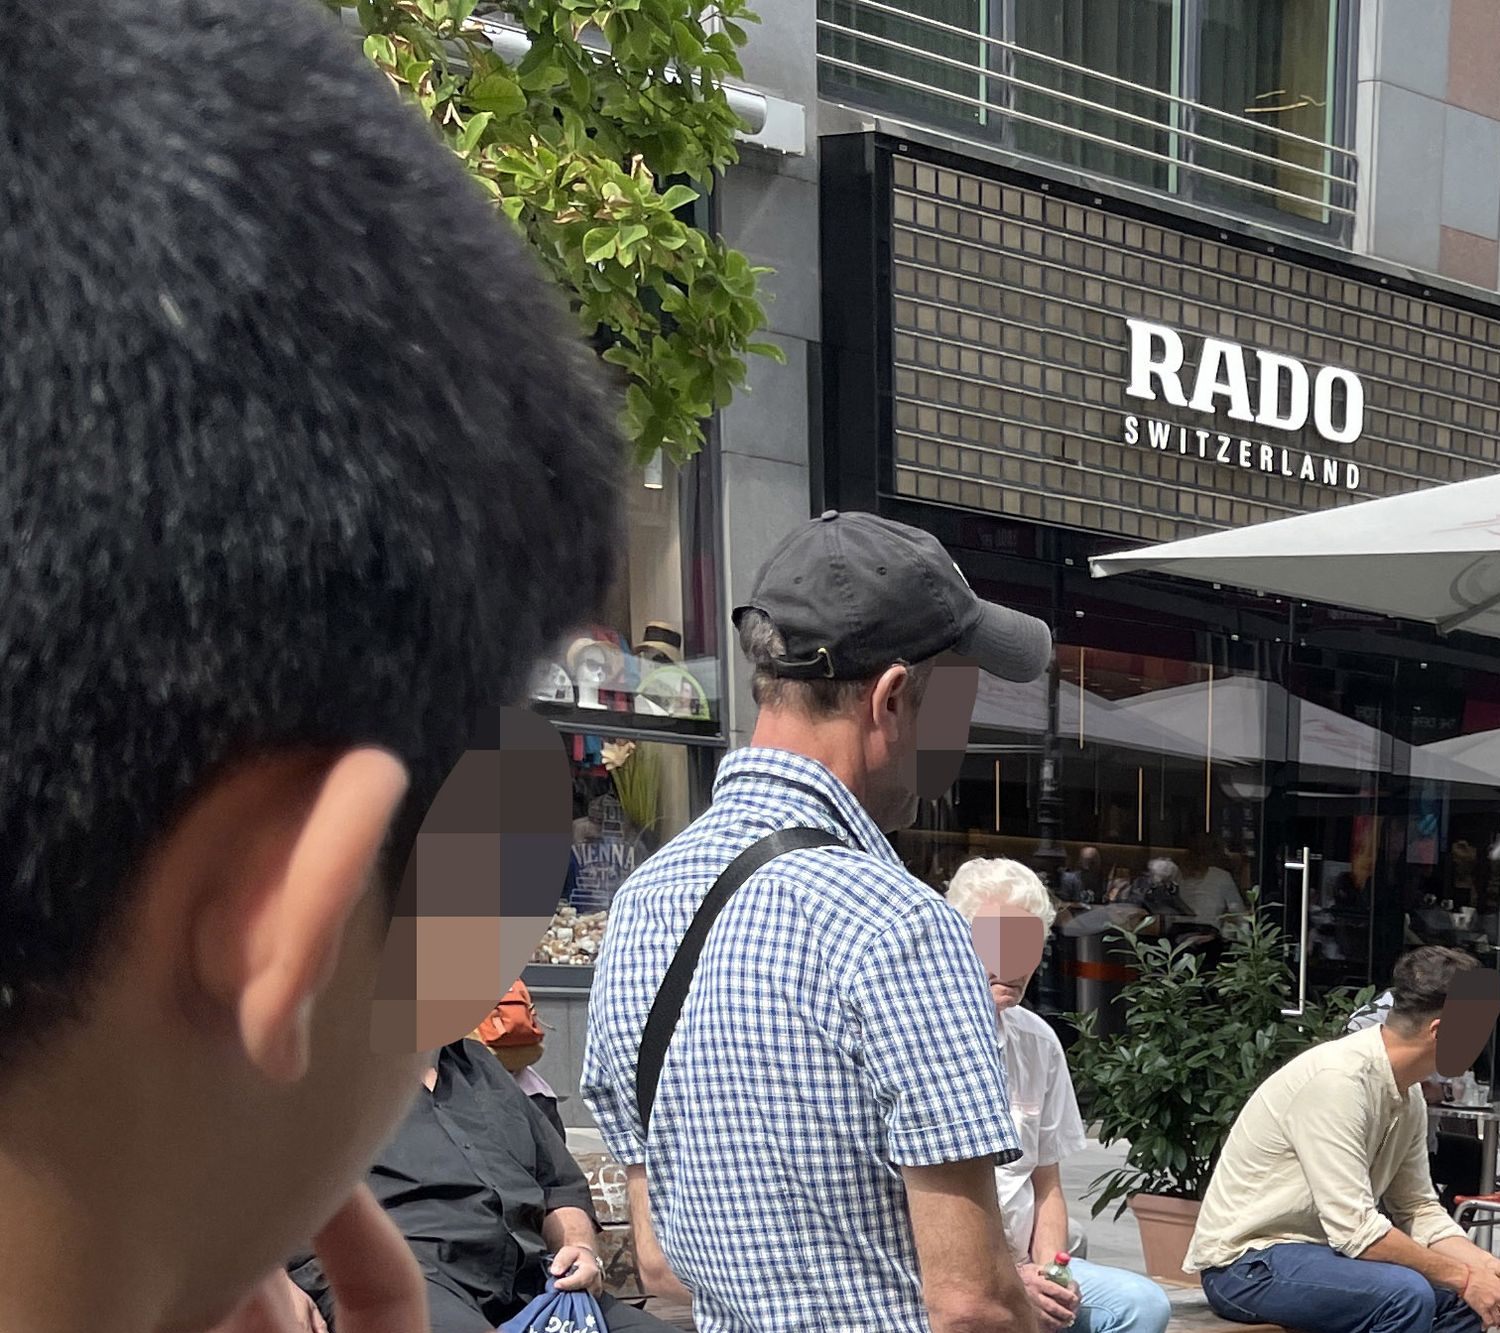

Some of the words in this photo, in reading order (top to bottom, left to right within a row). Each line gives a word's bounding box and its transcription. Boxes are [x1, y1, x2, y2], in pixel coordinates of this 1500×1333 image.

[1126, 318, 1364, 444] RADO
[1124, 415, 1360, 490] SWITZERLAND
[571, 843, 636, 870] VIENNA
